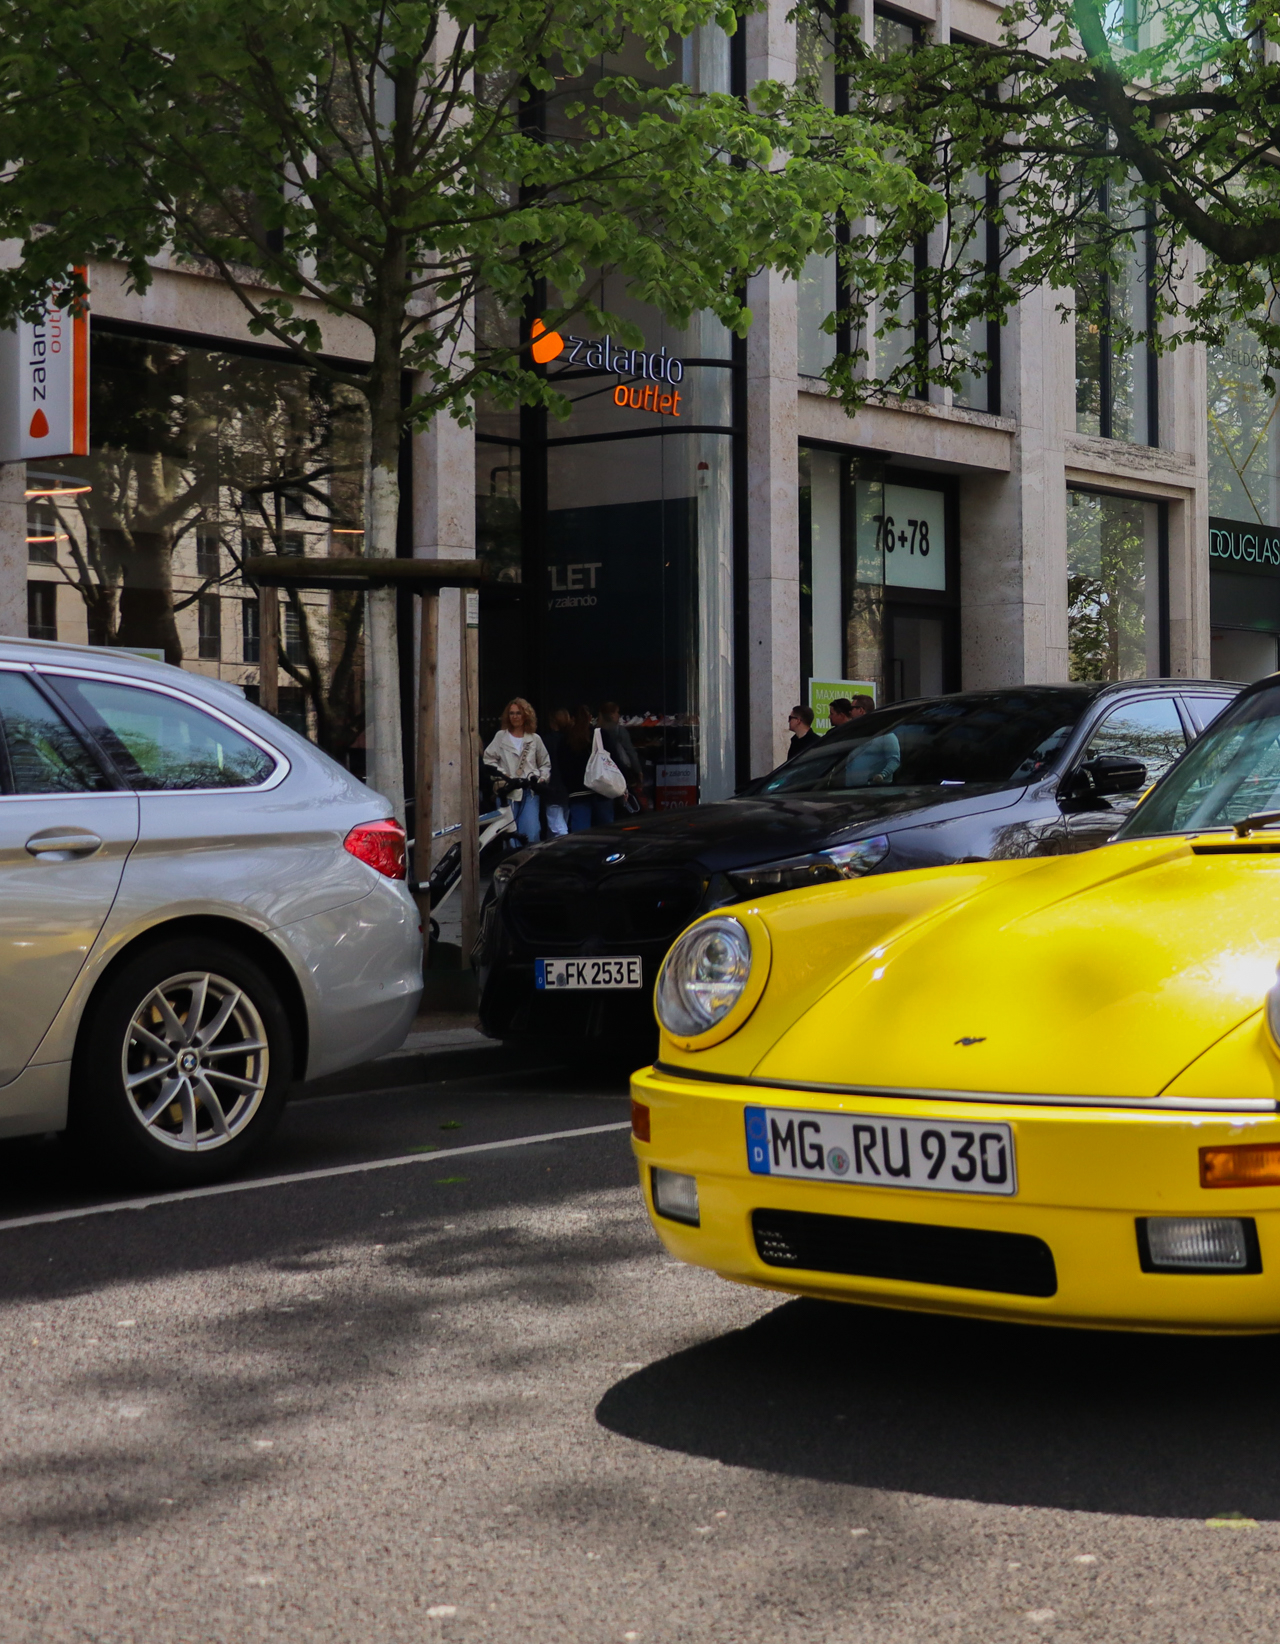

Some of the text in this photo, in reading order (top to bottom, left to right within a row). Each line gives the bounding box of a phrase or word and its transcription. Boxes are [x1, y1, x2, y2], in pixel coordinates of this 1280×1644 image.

[568, 334, 684, 385] zalando
[613, 384, 682, 417] outlet
[873, 515, 930, 557] 76+78
[1209, 528, 1280, 566] DOUGLAS
[555, 594, 598, 609] zalando
[816, 689, 859, 702] MAXIMAL
[545, 962, 556, 985] E
[565, 962, 588, 985] FK
[753, 1117, 1008, 1184] D MG RU 930
